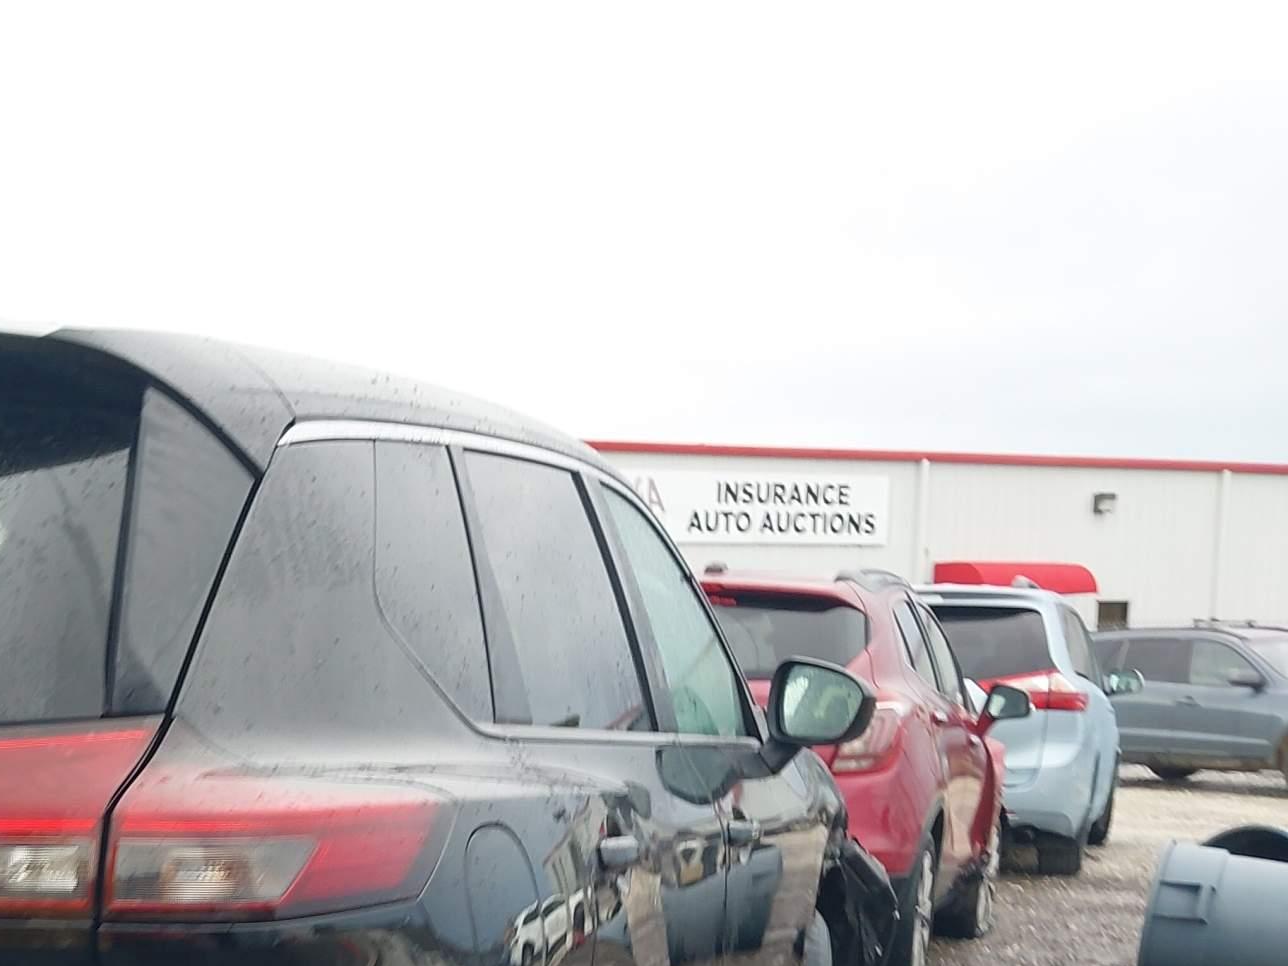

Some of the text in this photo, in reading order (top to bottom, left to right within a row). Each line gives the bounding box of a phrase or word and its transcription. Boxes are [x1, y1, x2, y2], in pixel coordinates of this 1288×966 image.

[716, 482, 851, 506] INSURANCE
[687, 511, 877, 535] AUTO AUCTIONS
